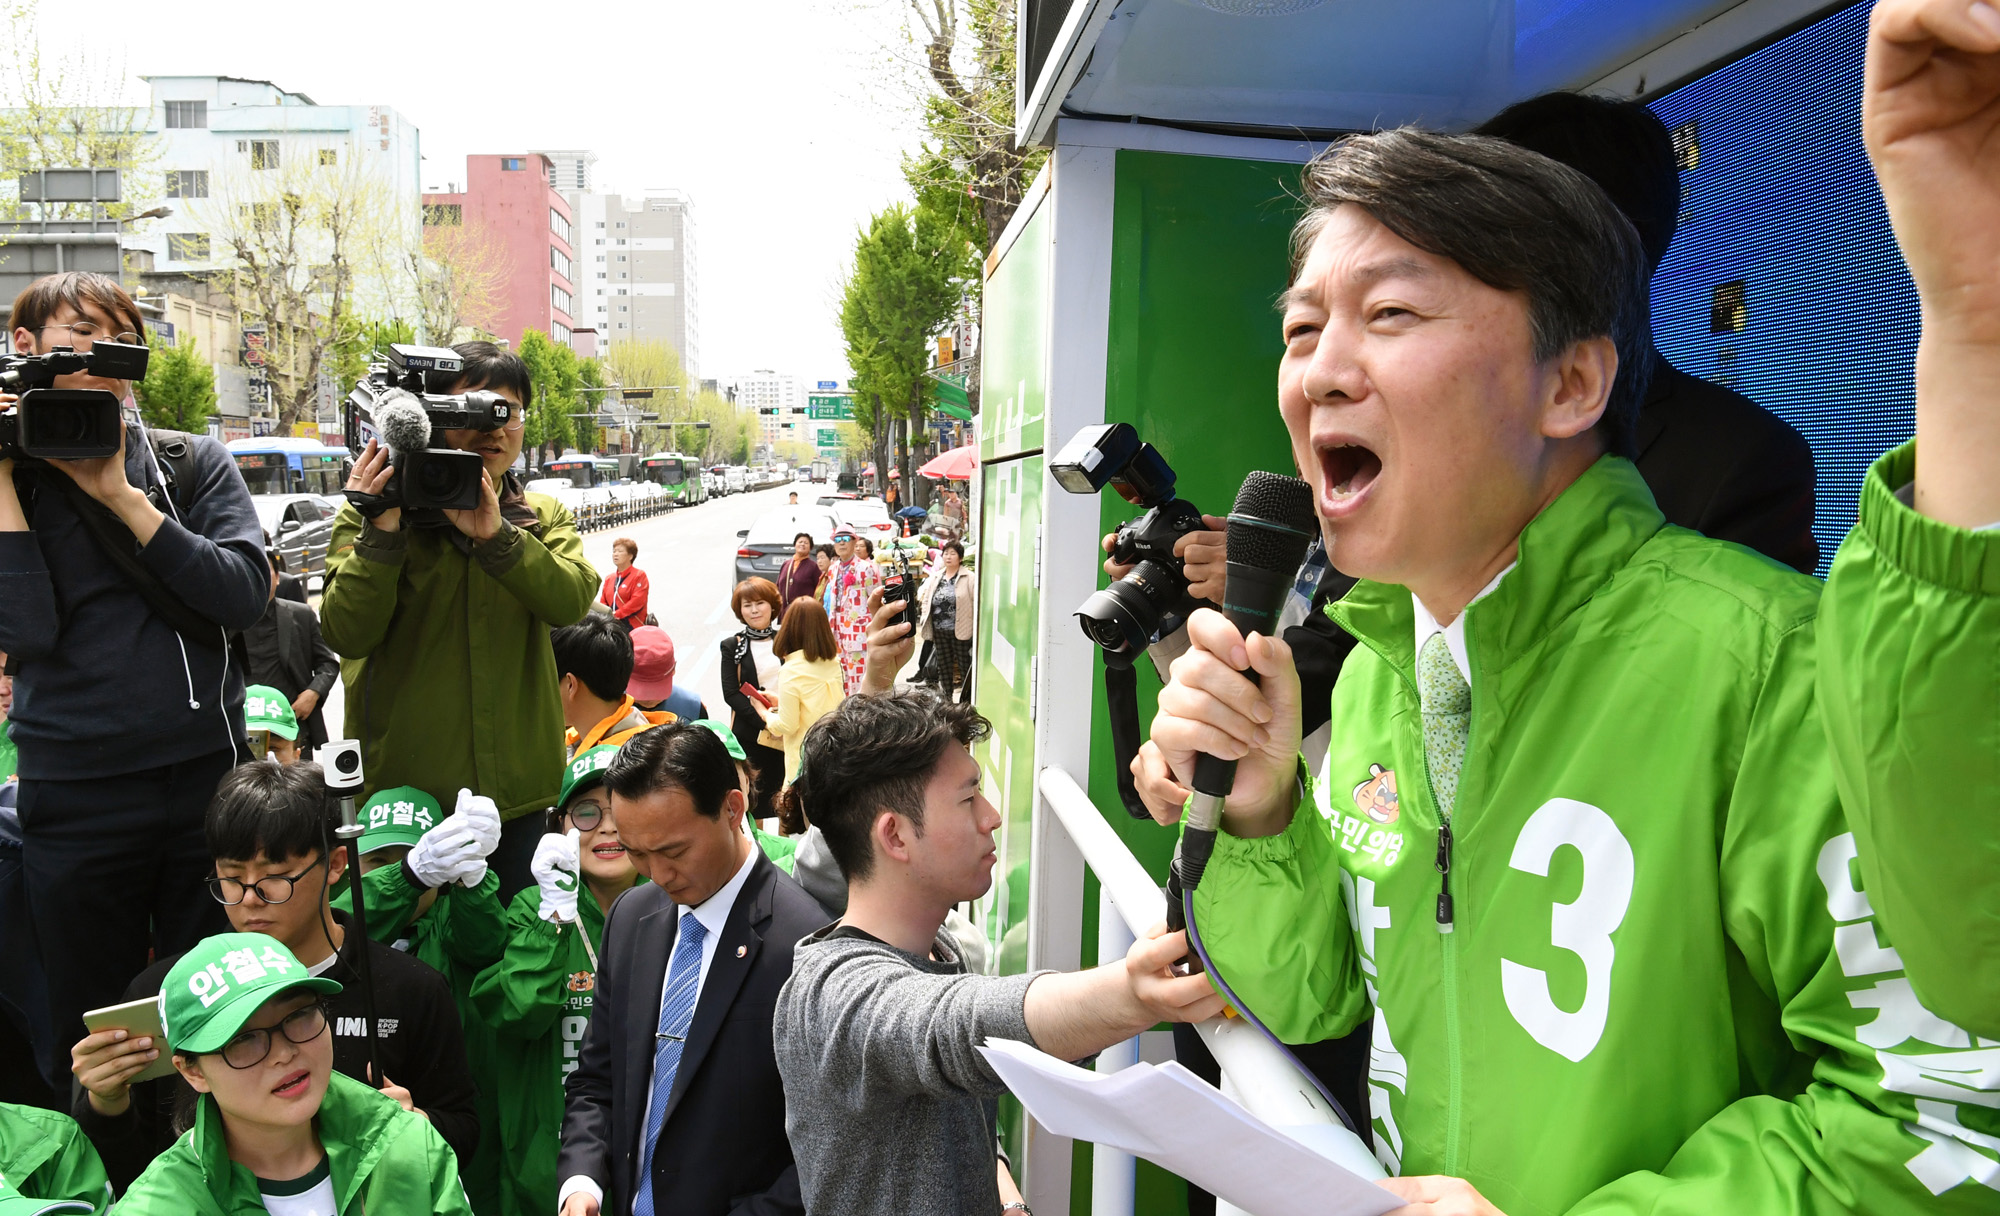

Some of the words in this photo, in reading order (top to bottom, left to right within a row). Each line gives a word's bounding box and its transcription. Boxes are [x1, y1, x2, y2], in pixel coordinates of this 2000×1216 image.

[408, 357, 433, 368] NEWS
[439, 360, 456, 370] TJB
[493, 404, 508, 418] TJB
[1135, 542, 1151, 550] Nikon
[243, 696, 283, 719] 철수
[369, 800, 434, 830] 안철수
[1501, 797, 1635, 1063] 3
[188, 946, 293, 1009] 안철수
